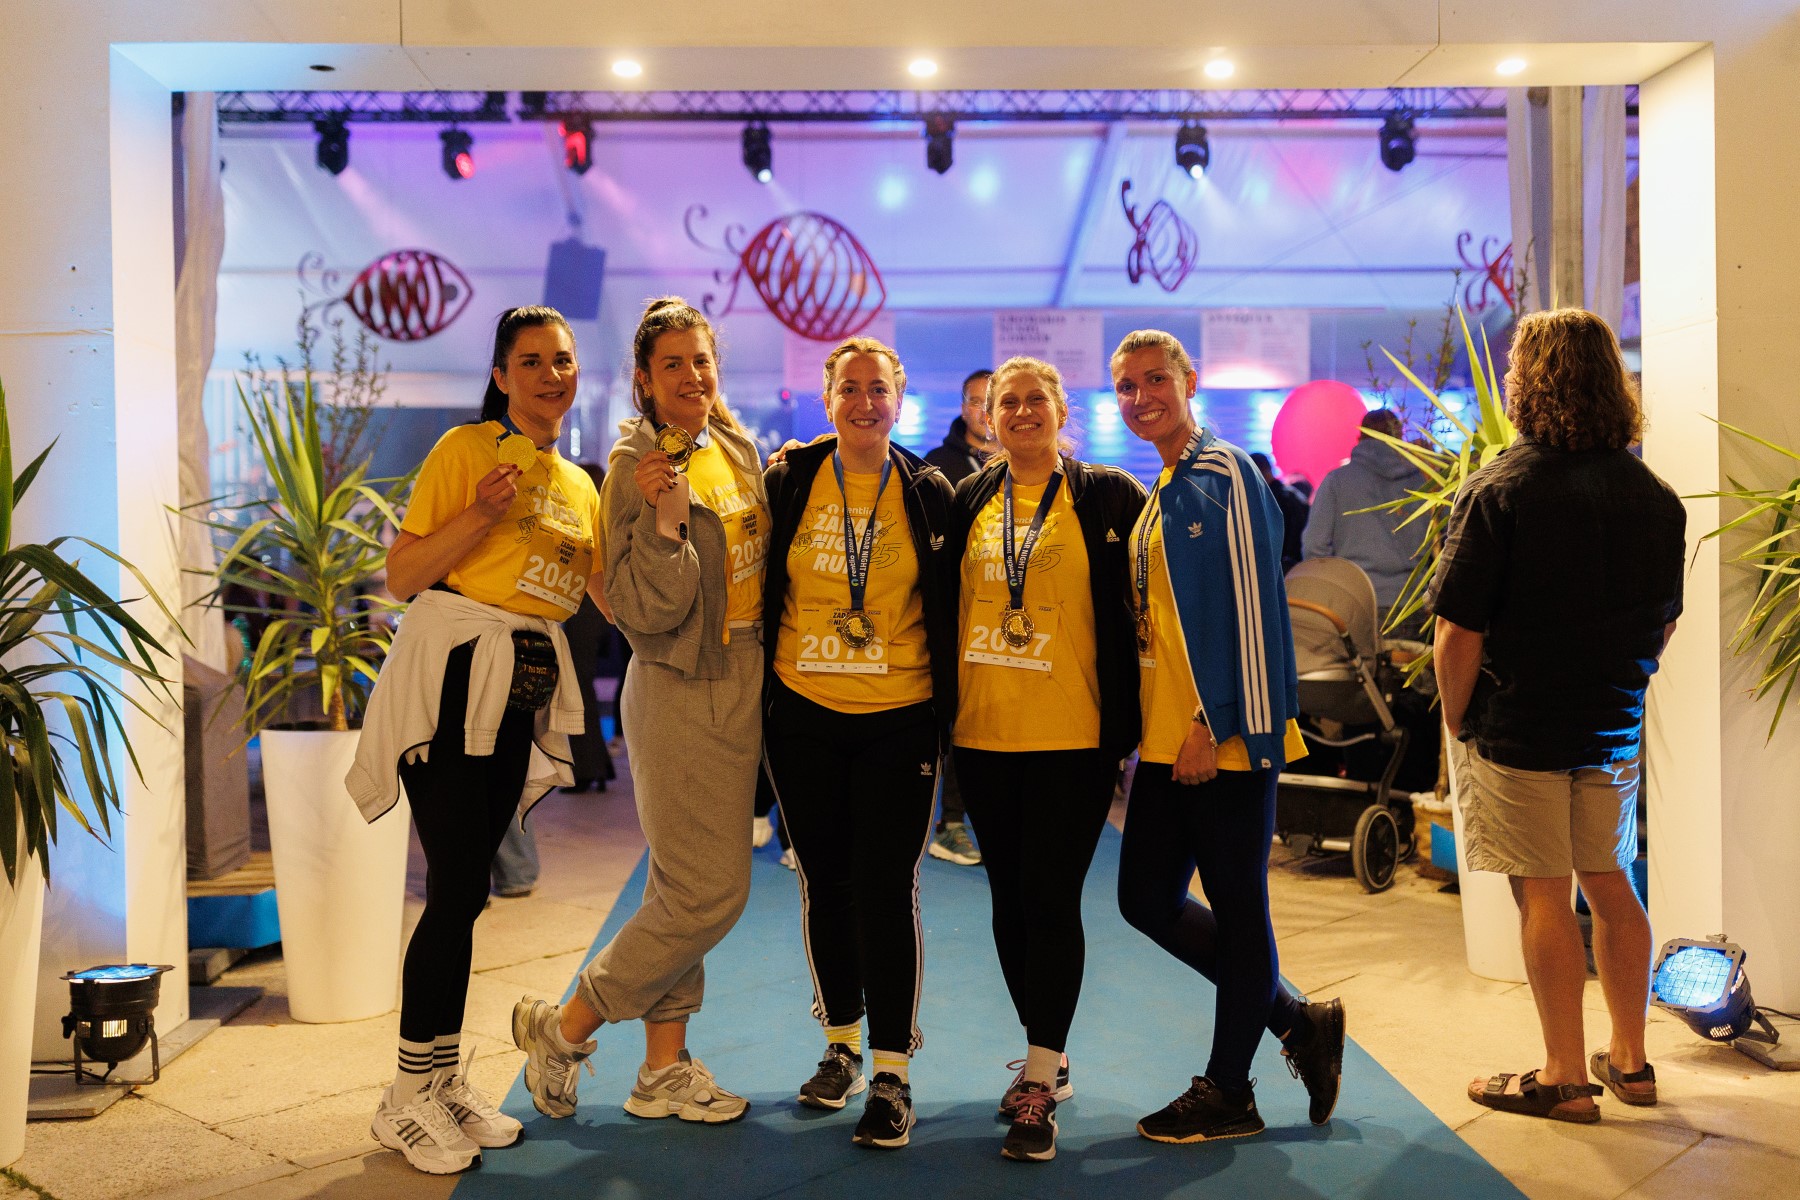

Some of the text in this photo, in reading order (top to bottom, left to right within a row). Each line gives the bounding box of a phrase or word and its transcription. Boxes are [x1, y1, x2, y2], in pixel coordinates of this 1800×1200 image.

[863, 528, 872, 550] ZADAR
[1024, 529, 1037, 548] ZADAR
[859, 550, 869, 571] NIGHT
[1018, 549, 1028, 570] NIGHT
[523, 555, 586, 599] 2042
[984, 562, 1007, 581] RU
[969, 625, 1052, 657] 207
